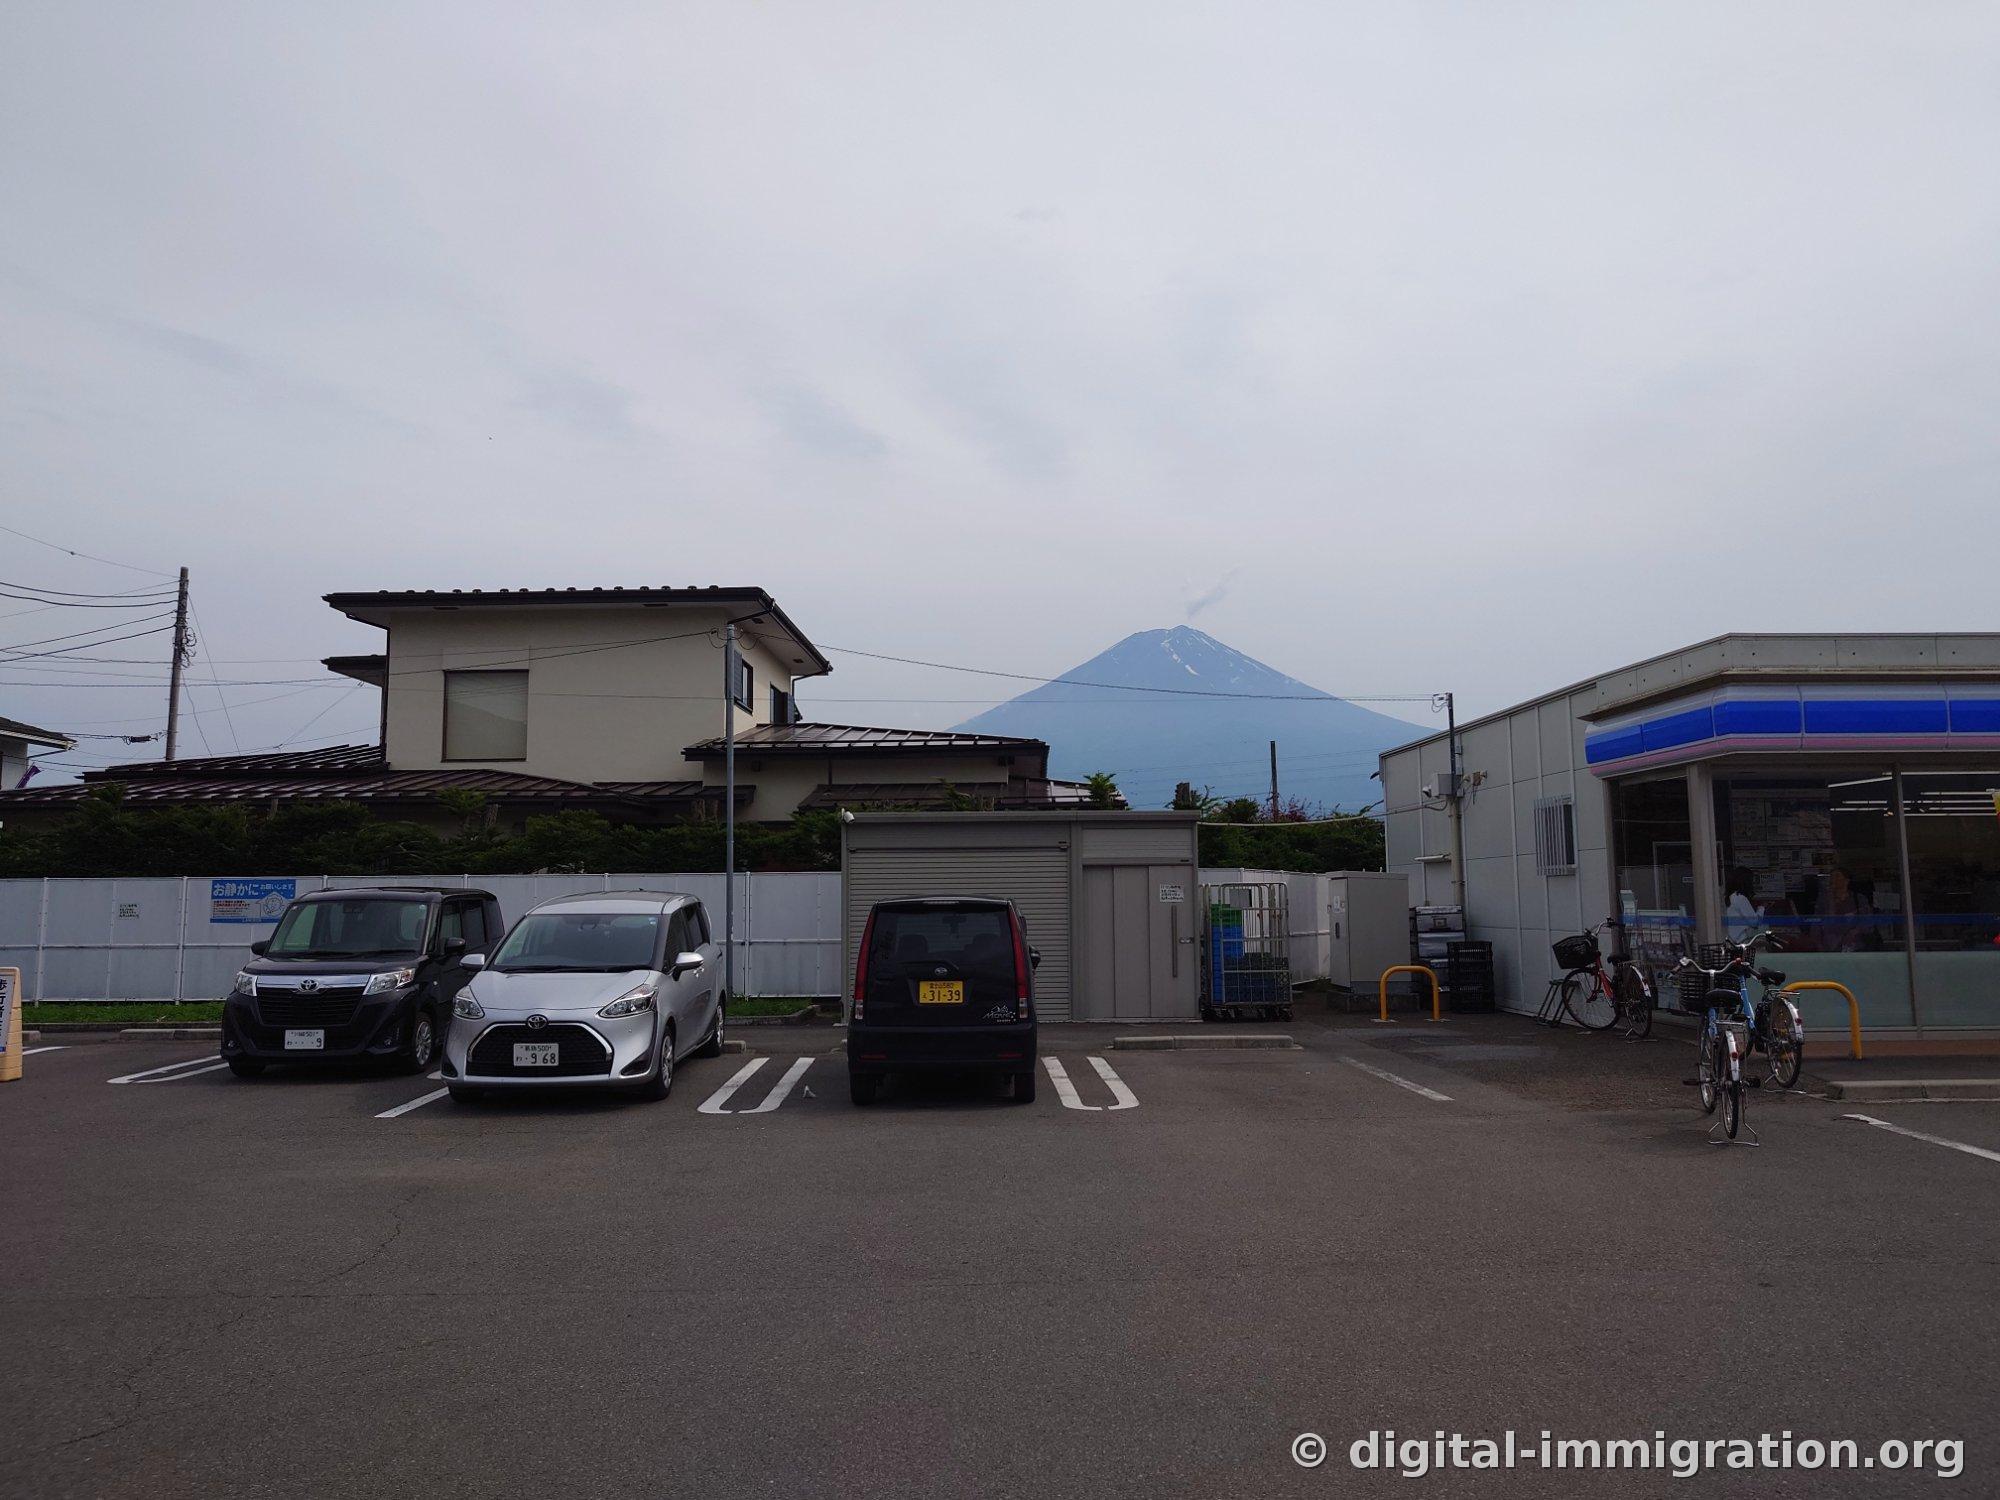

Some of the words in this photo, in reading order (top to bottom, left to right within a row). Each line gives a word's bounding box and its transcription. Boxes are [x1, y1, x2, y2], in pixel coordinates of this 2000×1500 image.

[213, 882, 259, 897] お静かに
[928, 989, 961, 1001] 31-39
